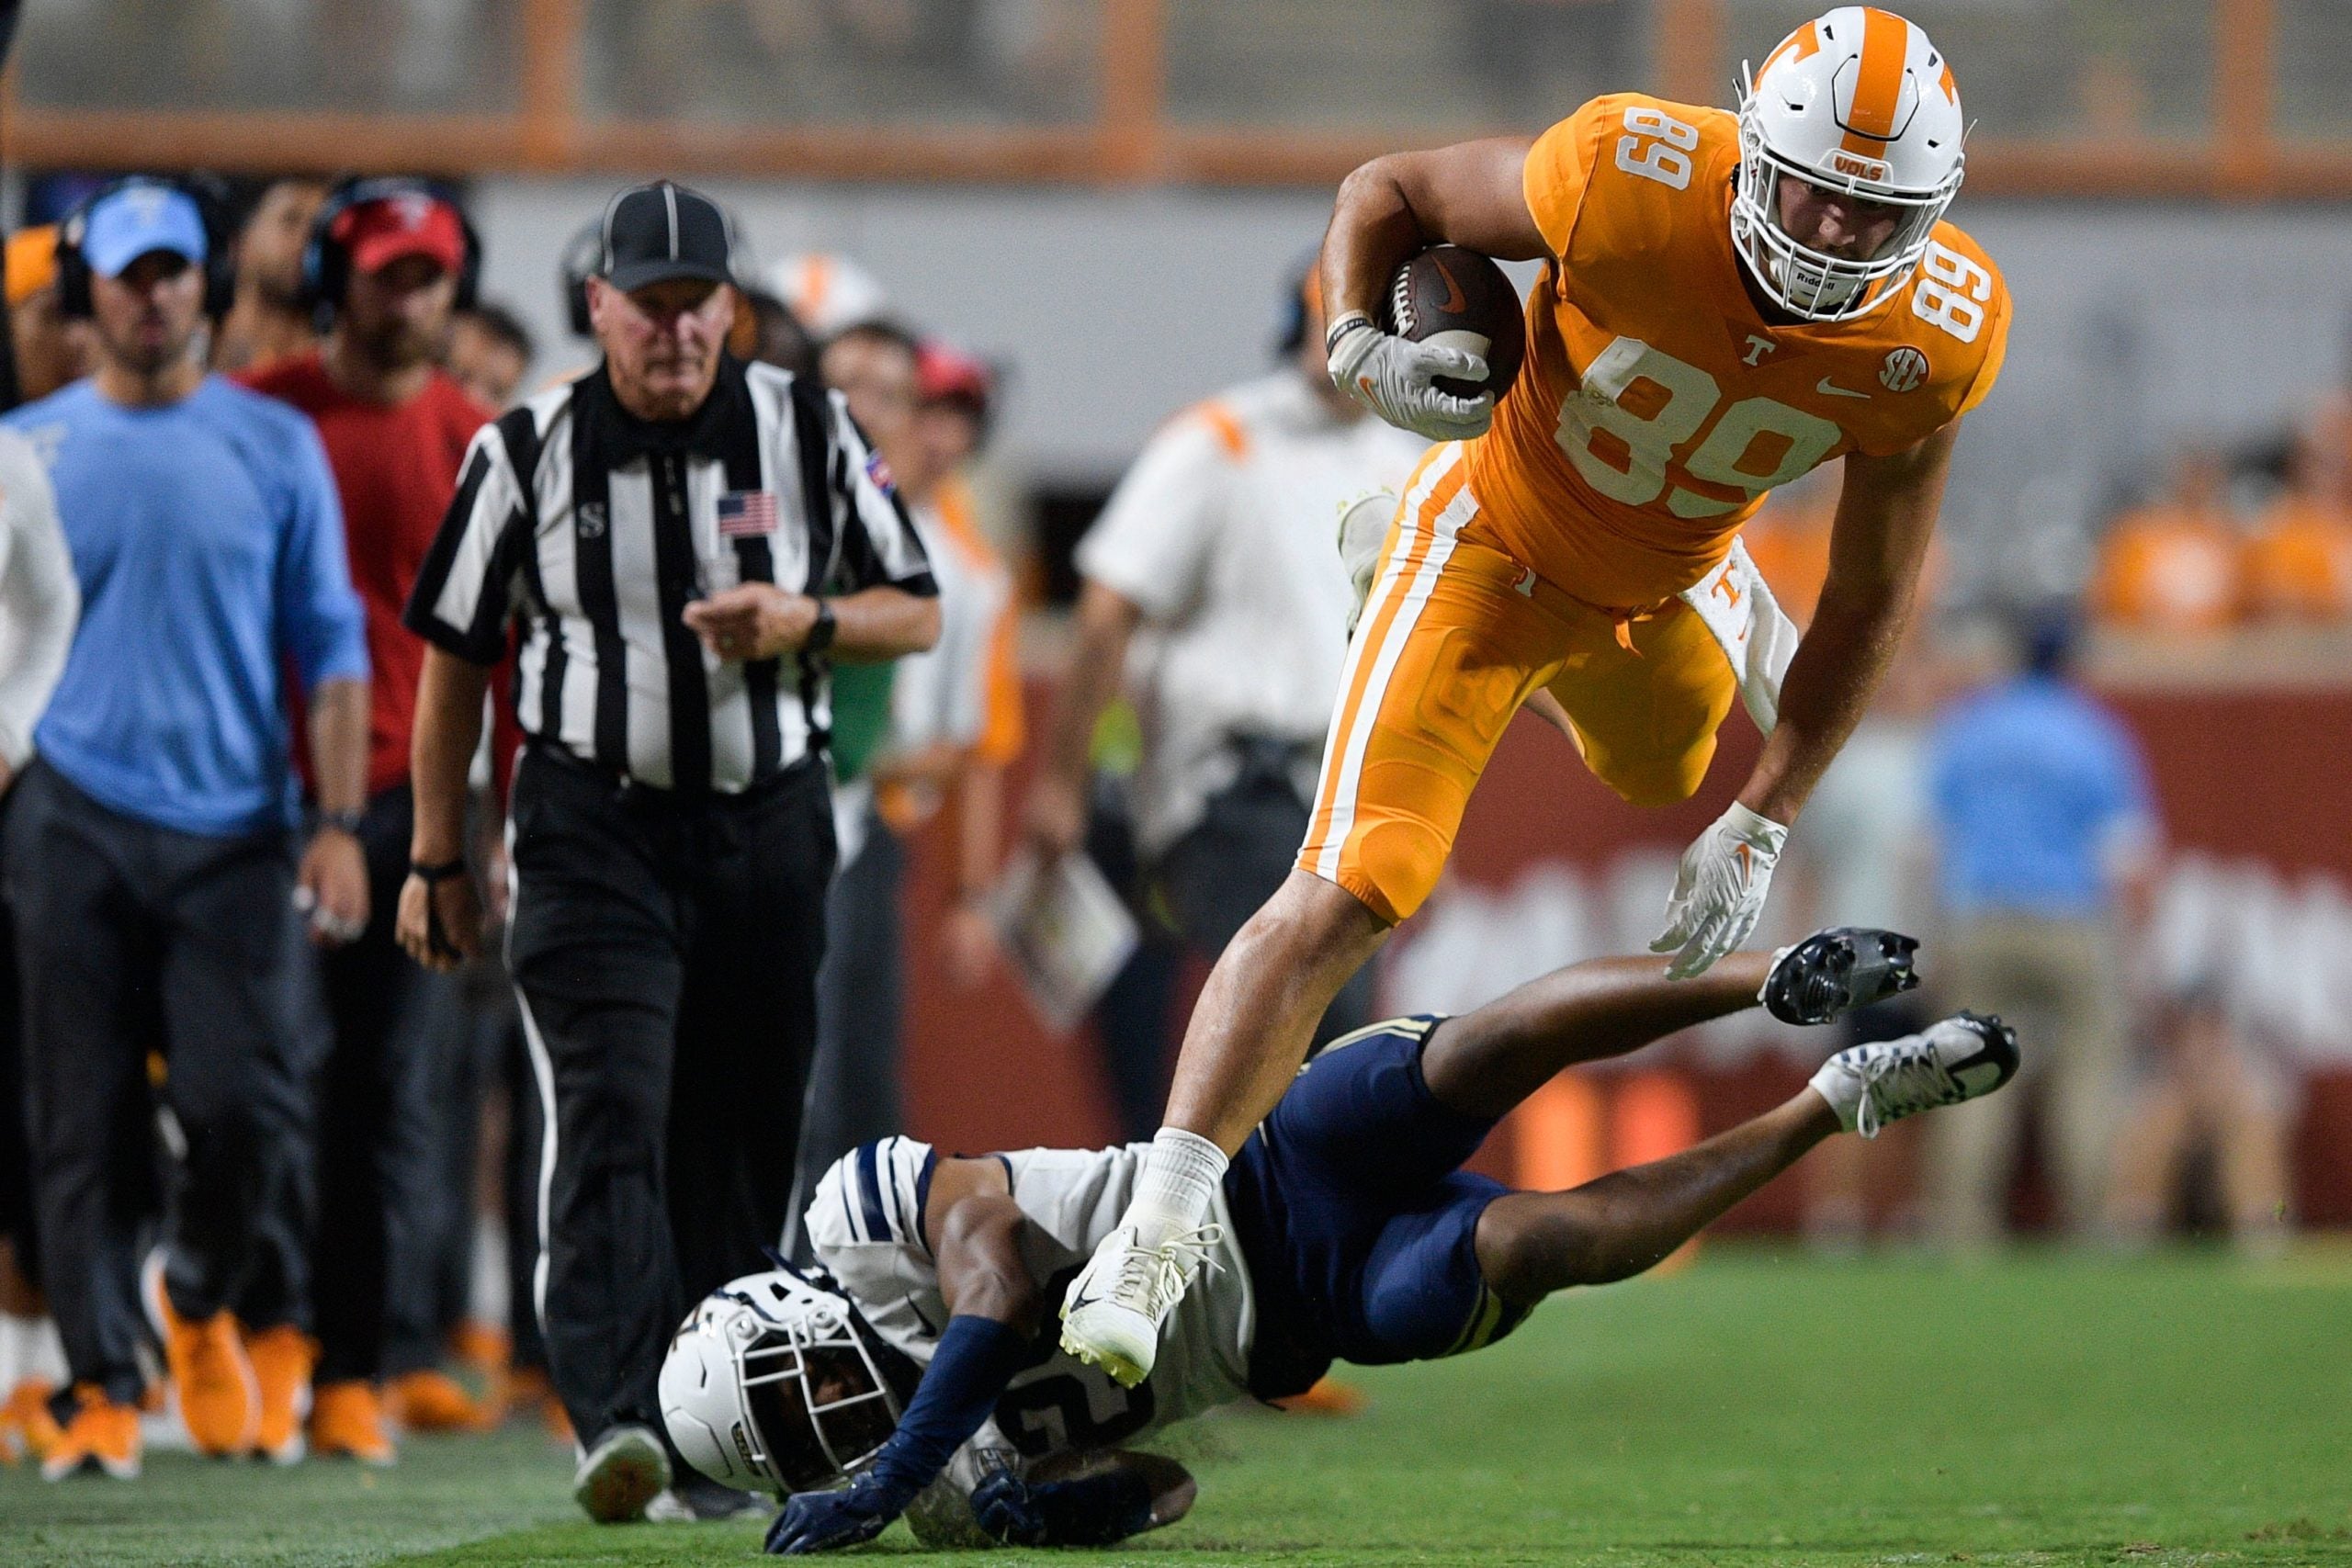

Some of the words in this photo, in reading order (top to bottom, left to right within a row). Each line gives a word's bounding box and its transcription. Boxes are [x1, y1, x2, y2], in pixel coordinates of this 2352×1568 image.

[1615, 106, 1699, 191] 89
[1835, 155, 1884, 182] VOLS
[1796, 272, 1836, 291] Riddll
[1911, 239, 1992, 344] 89
[1742, 334, 1777, 367] T
[1878, 347, 1928, 393] SEC
[1553, 335, 1843, 519] 89
[578, 501, 605, 539] S
